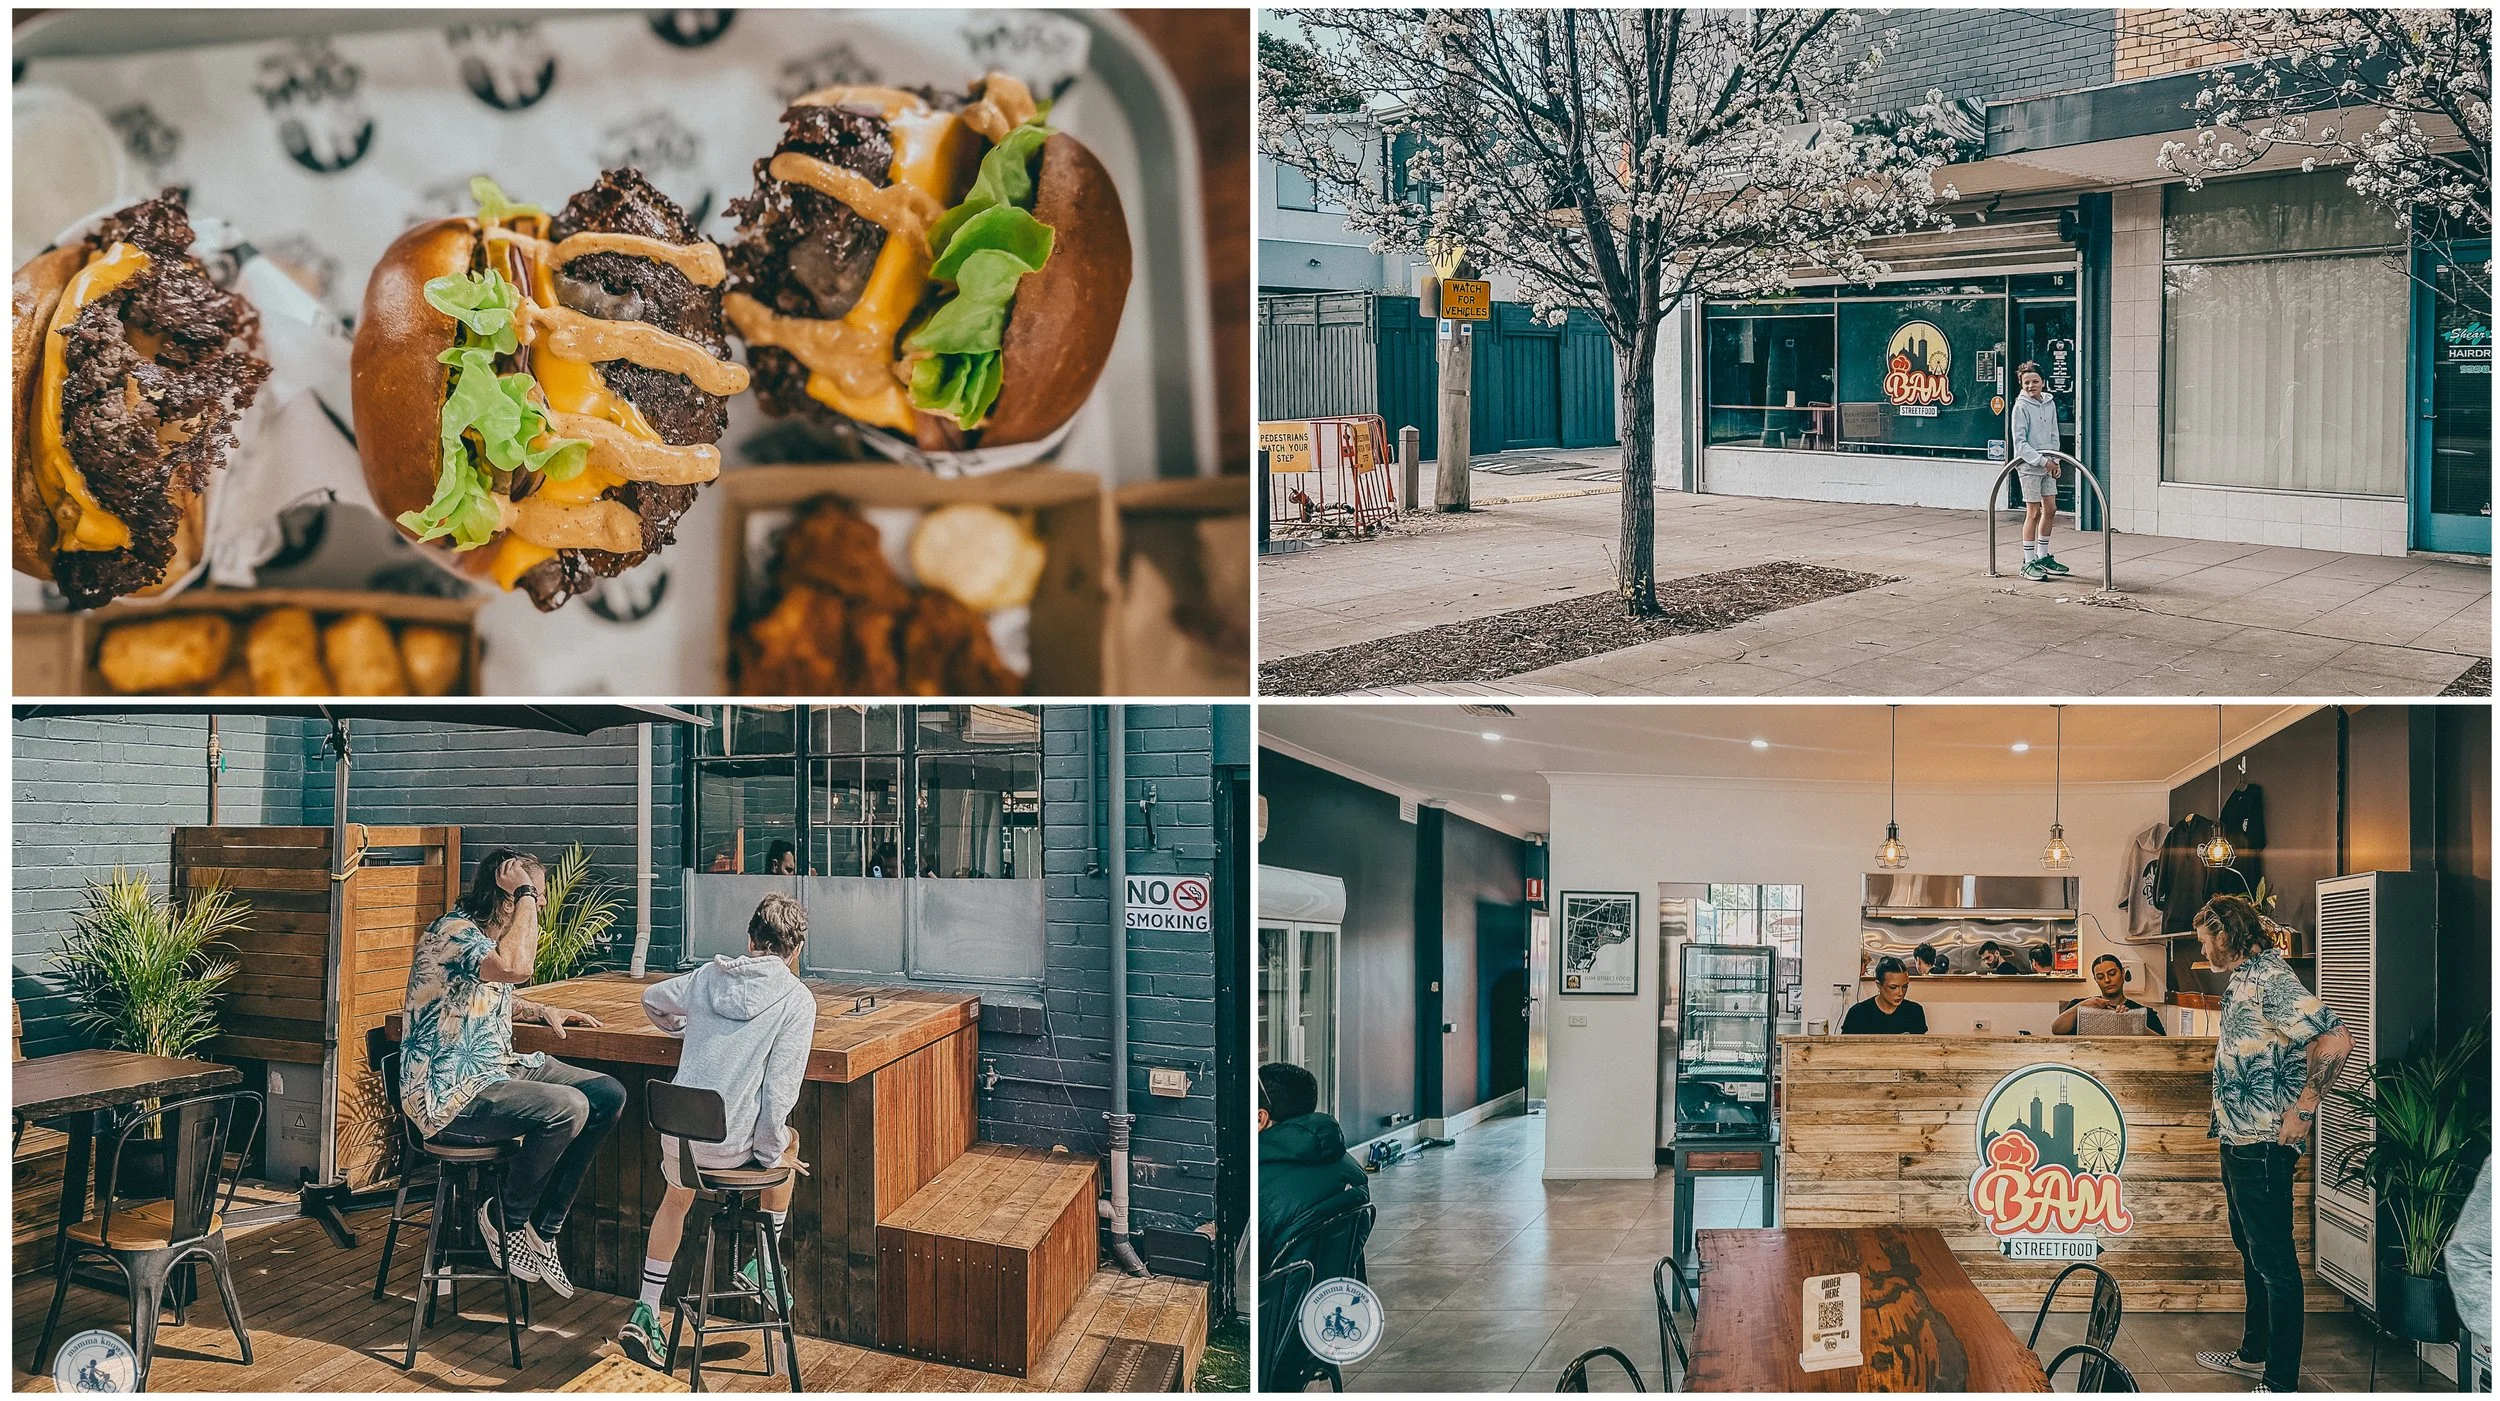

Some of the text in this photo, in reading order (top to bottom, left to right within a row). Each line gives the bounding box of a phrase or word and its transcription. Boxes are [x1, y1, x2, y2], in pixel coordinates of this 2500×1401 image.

[2053, 275, 2064, 286] 16
[1452, 283, 1482, 294] WATCH
[1457, 295, 1475, 304] FOR
[1445, 306, 1488, 316] VEHICLES
[2450, 327, 2486, 340] Shear
[2448, 349, 2492, 358] HAIRDR
[1884, 371, 1953, 405] BAM
[1260, 433, 1309, 442] PEDESTRIANS
[1261, 443, 1309, 452] WATCH YOUR
[1276, 454, 1295, 463] STEP
[1127, 880, 1170, 905] NO
[1126, 913, 1208, 930] SMOKING
[1975, 1167, 2130, 1233] BAM
[1821, 1277, 1841, 1290] ORDER
[1824, 1287, 1840, 1299] HERE
